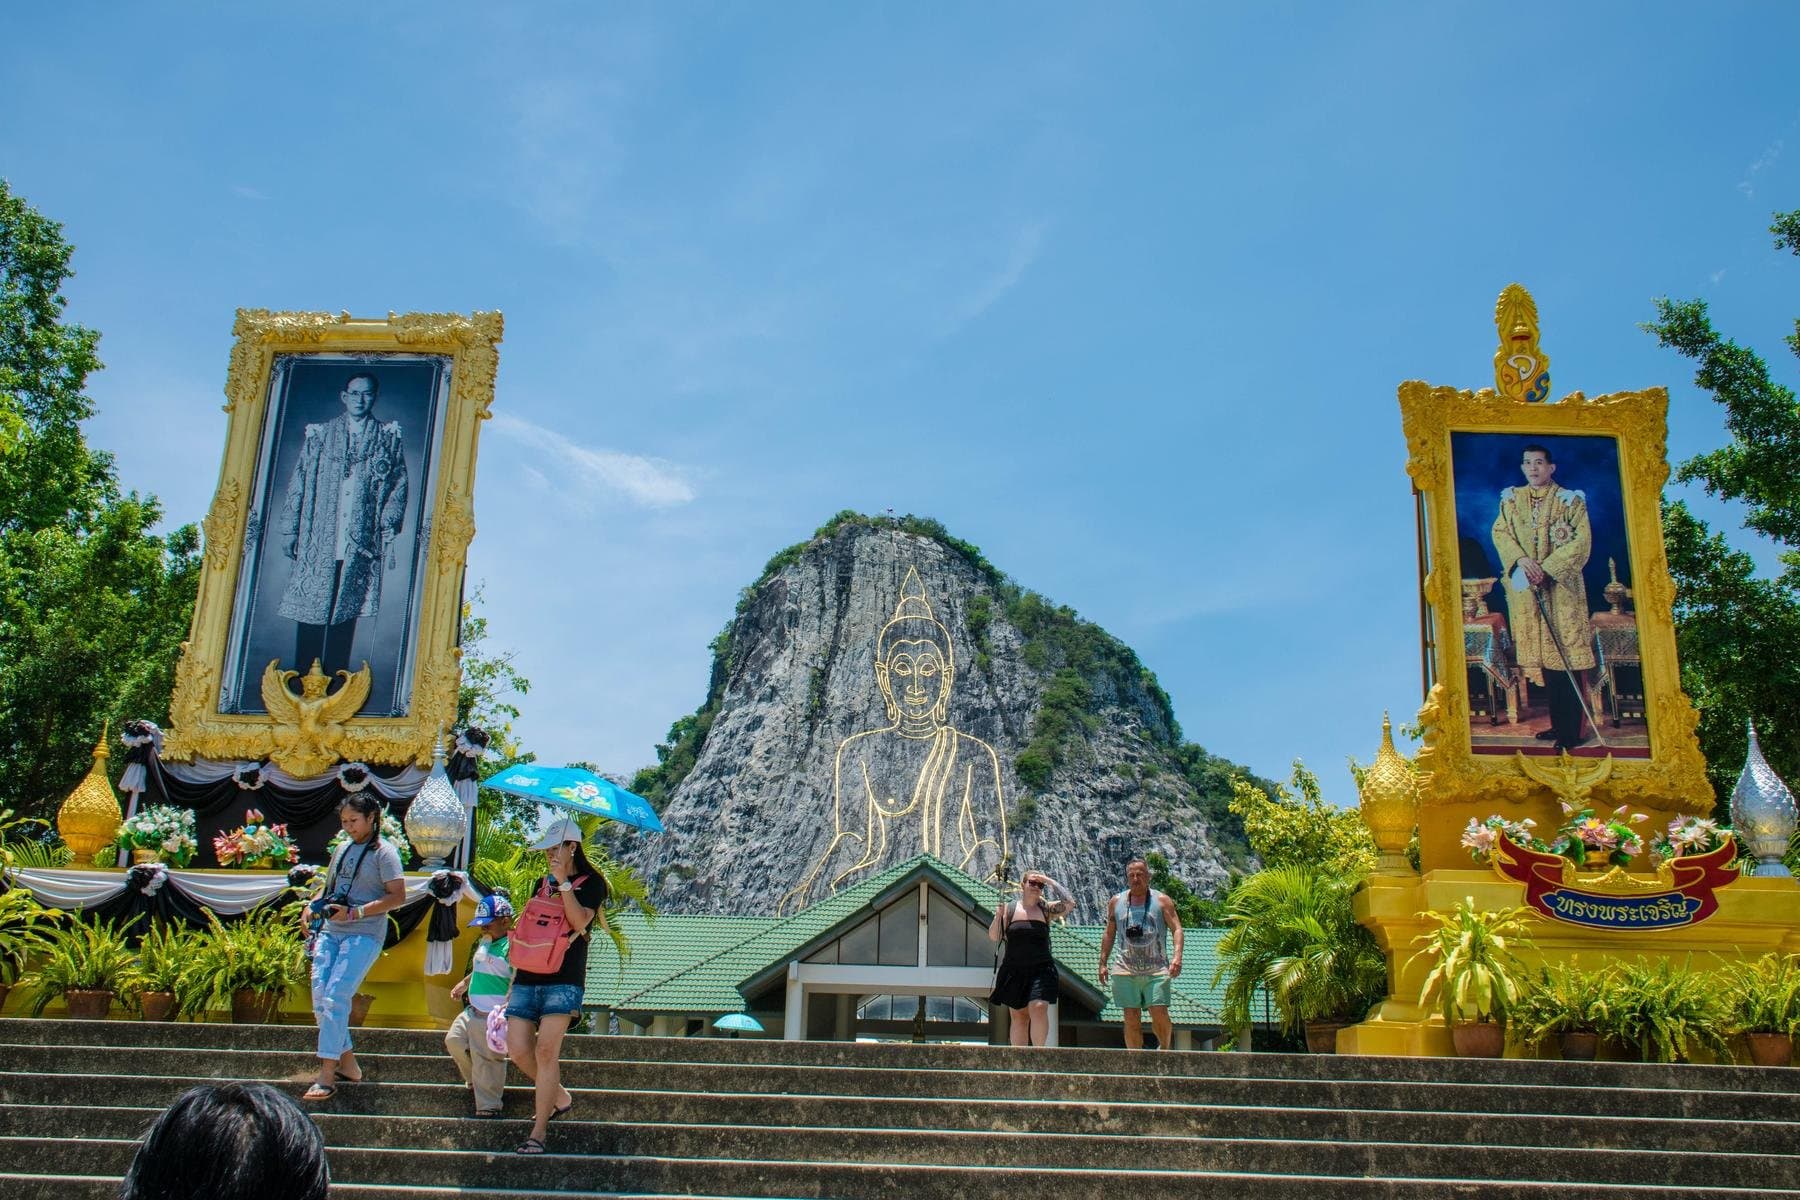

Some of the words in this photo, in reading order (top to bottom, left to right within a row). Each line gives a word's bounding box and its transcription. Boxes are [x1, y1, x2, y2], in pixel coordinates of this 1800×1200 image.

[1556, 896, 1688, 921] ทรงพระเจริญ
